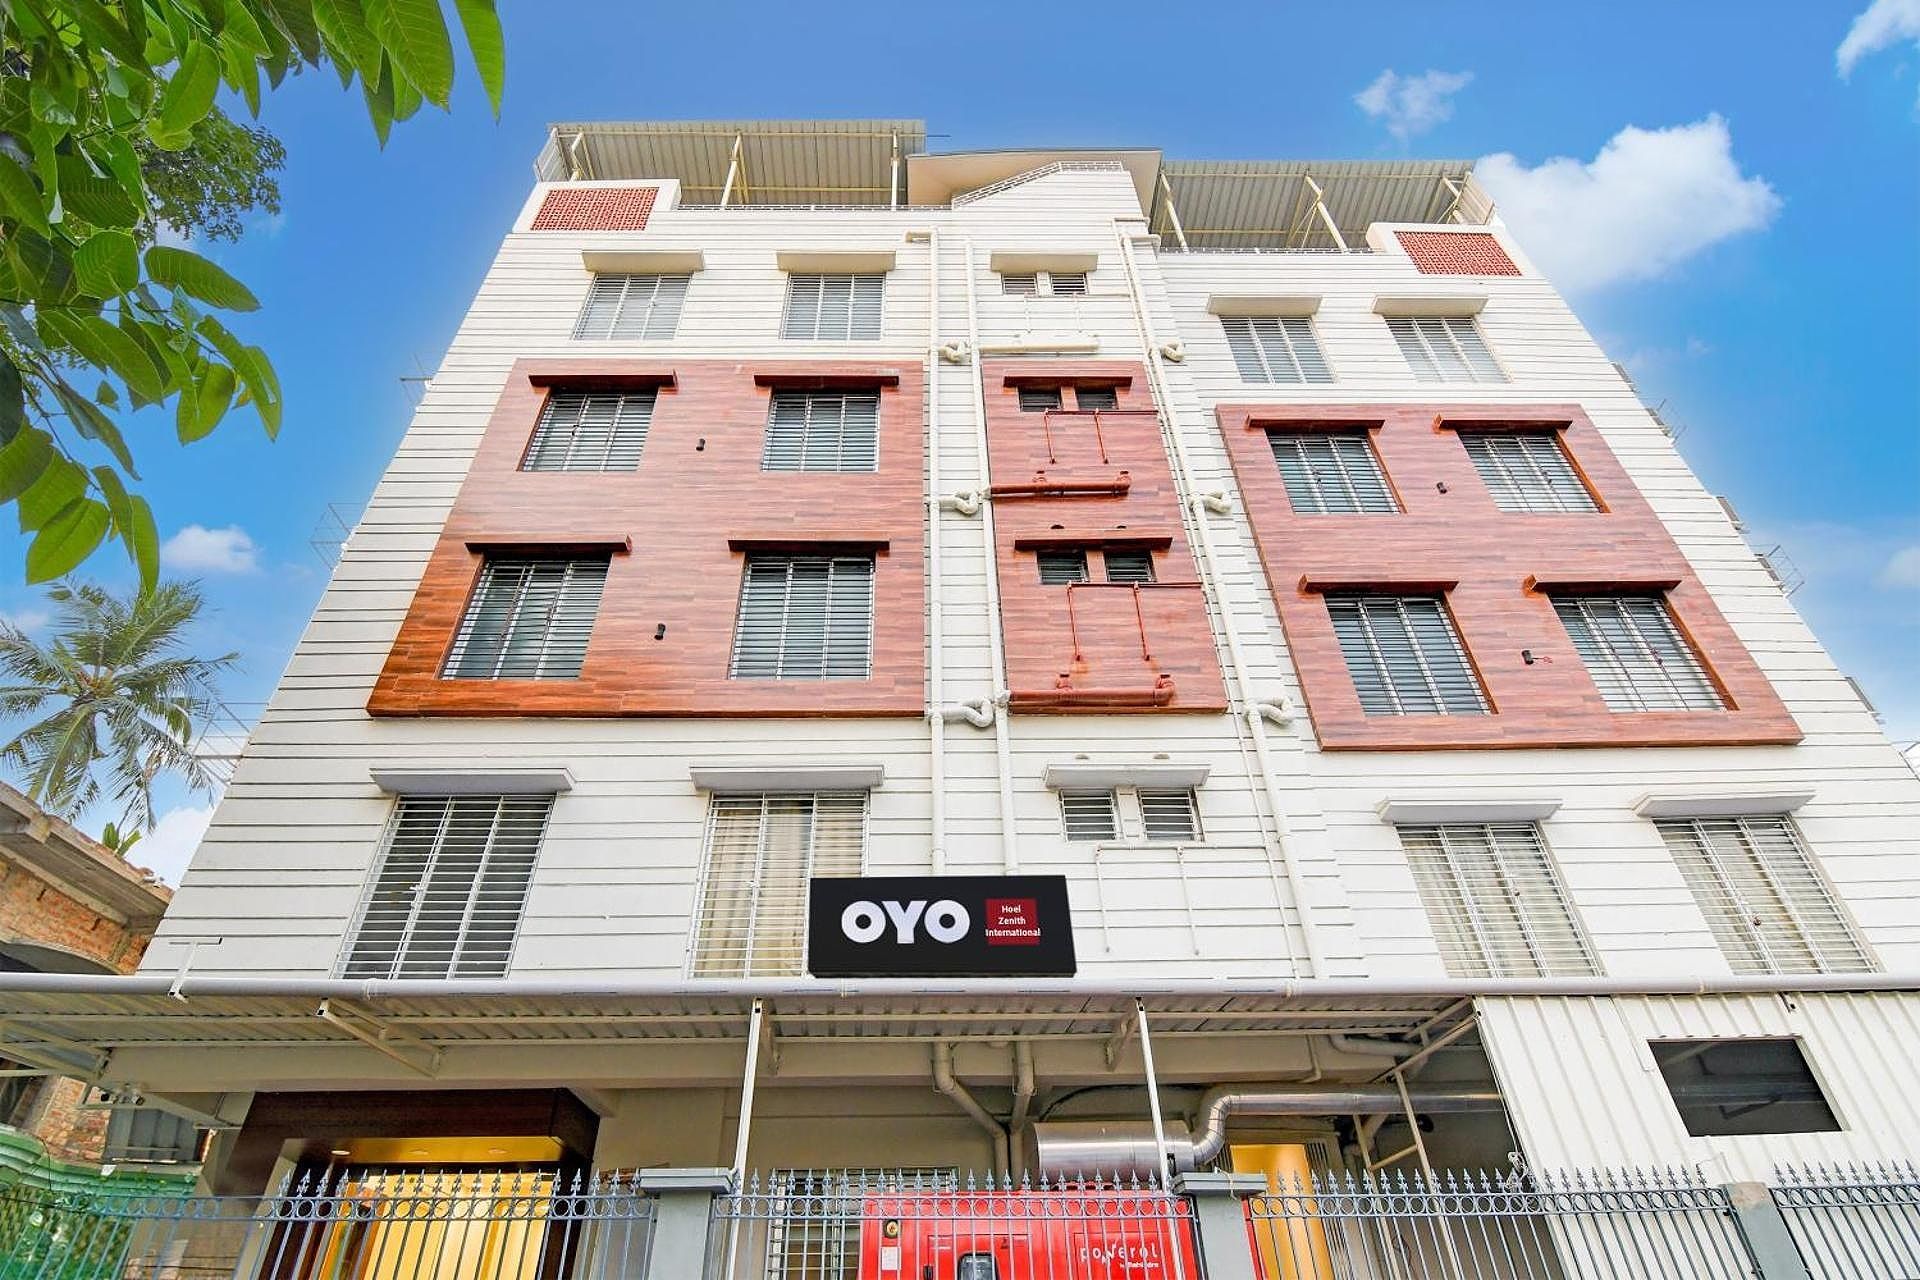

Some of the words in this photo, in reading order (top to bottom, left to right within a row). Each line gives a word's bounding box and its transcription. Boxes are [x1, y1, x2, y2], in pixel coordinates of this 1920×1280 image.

[1001, 905, 1022, 913] Hoel
[841, 899, 971, 944] OYO
[998, 917, 1026, 925] Zenith
[985, 927, 1042, 937] International
